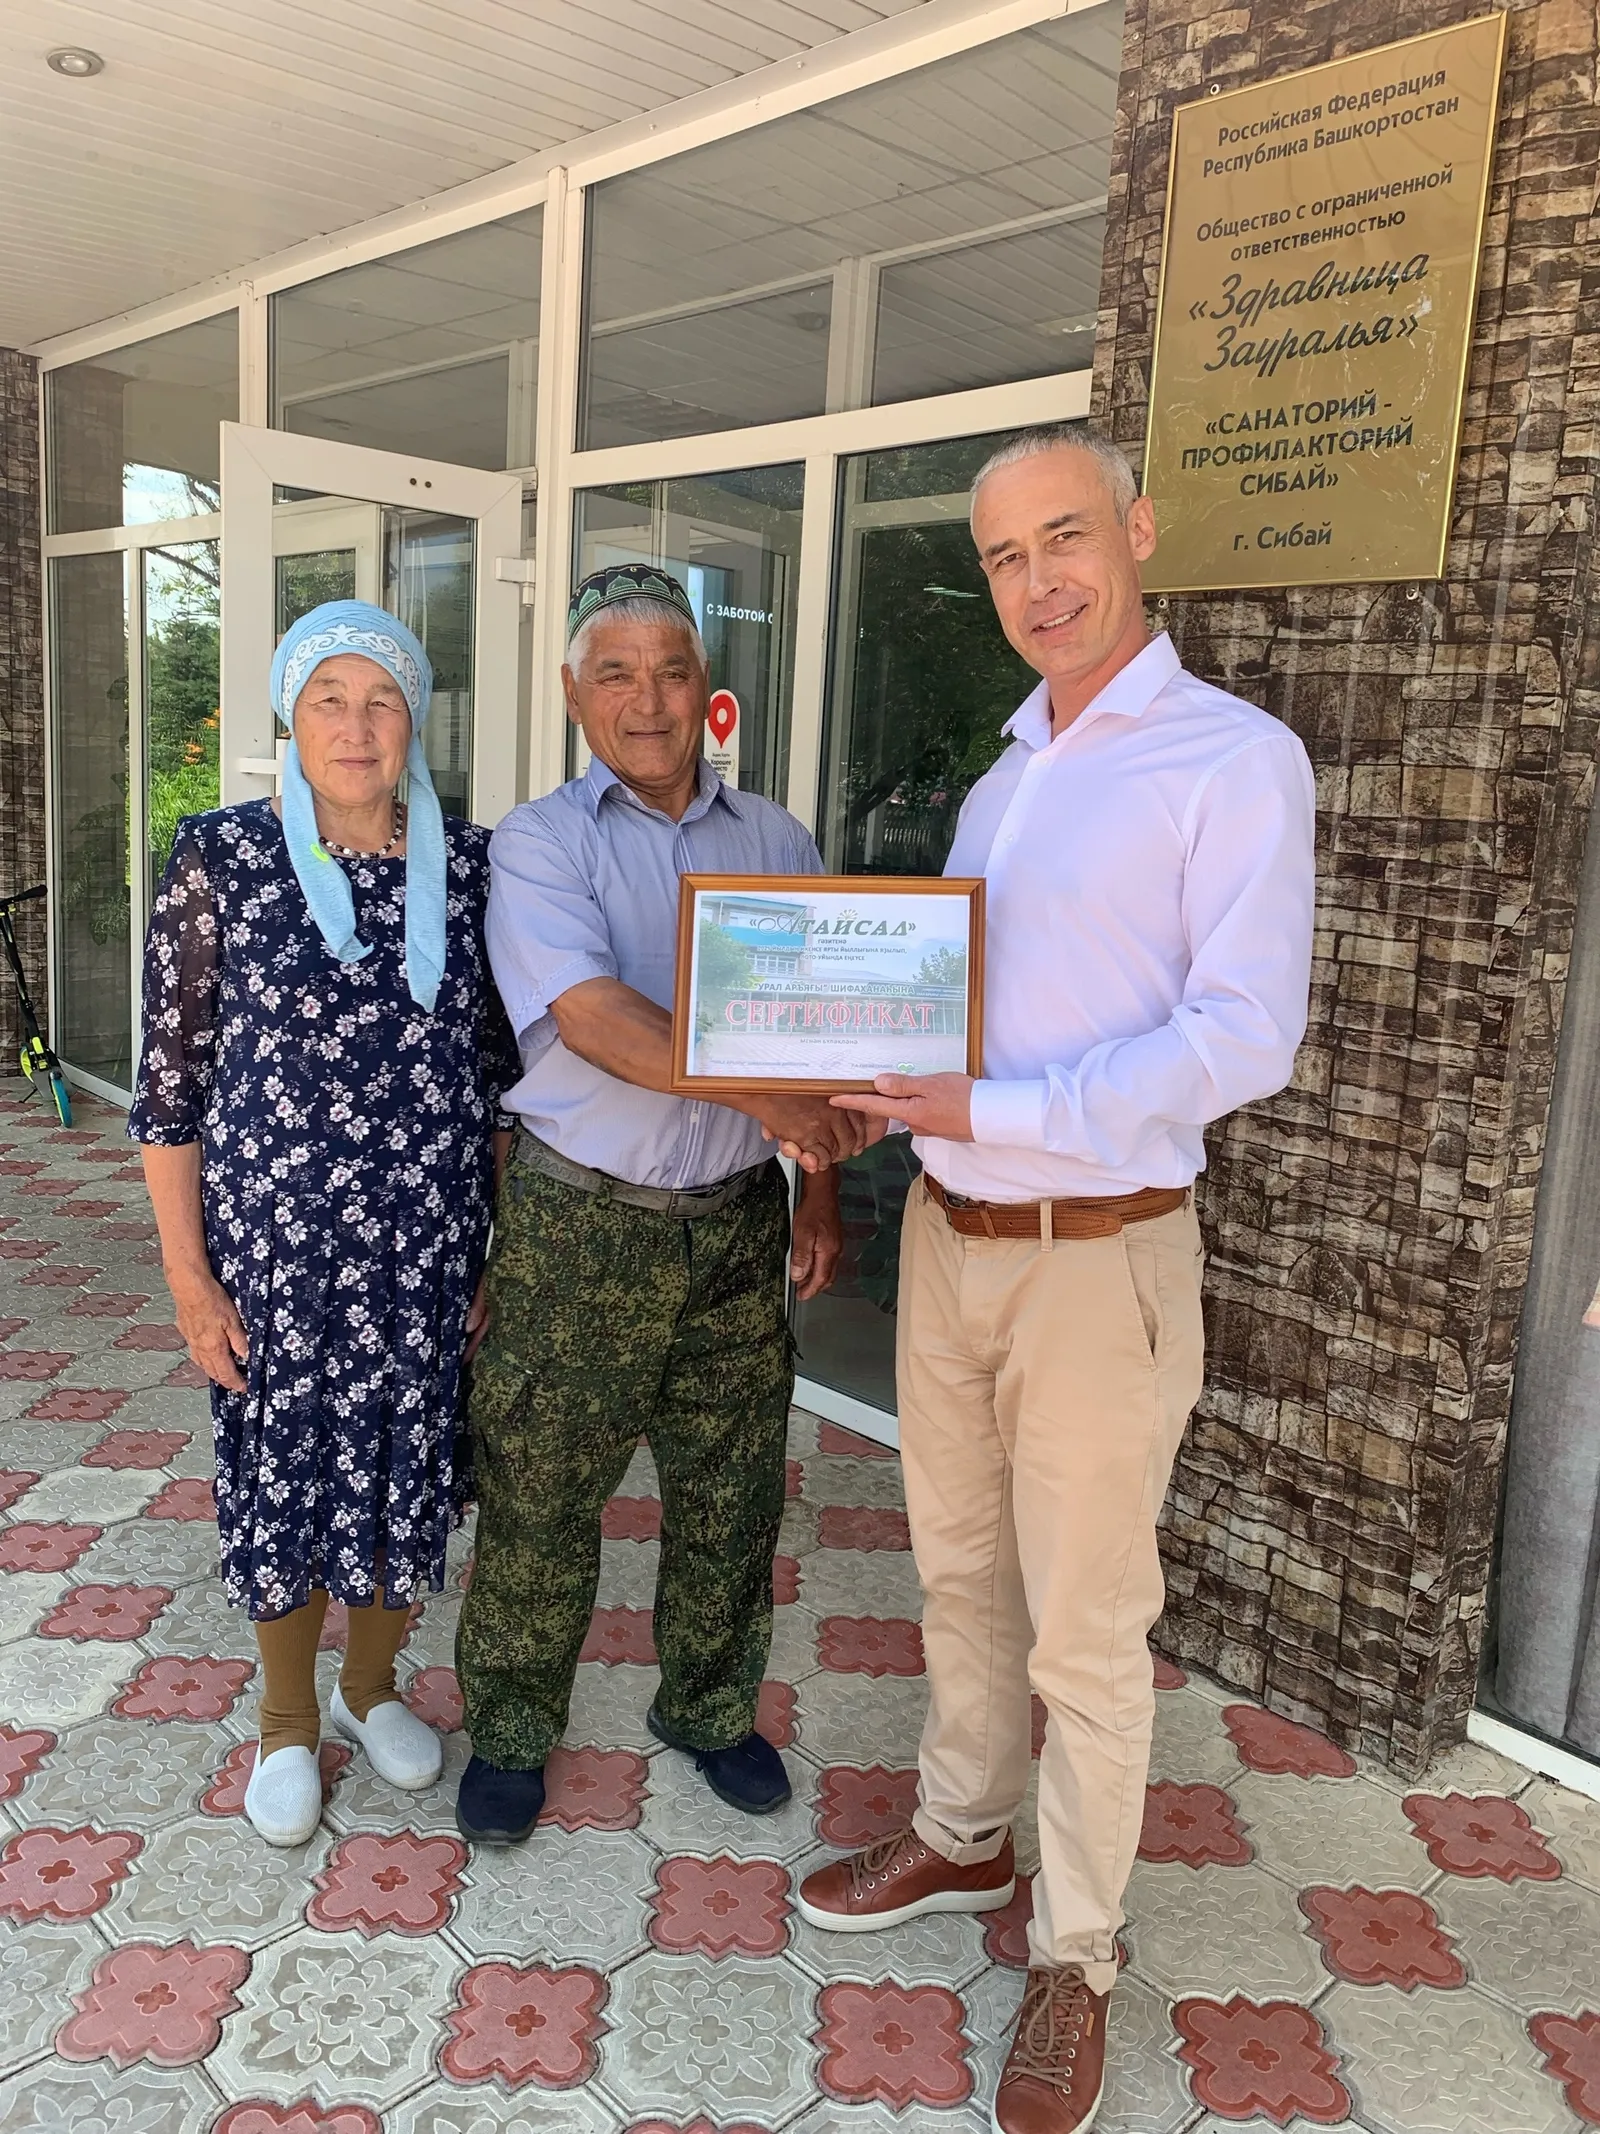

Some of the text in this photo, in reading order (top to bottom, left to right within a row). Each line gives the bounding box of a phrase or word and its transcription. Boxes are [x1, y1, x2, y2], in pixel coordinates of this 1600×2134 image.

[1217, 69, 1447, 147] Российская Федерация
[1202, 96, 1459, 178] Республика Башкортостан
[1196, 164, 1454, 243] Общество с ограниченной
[1230, 208, 1406, 262] ответственностью
[1205, 388, 1377, 436] «САНАТОРИЙ
[1180, 416, 1412, 470] ПРОФИЛАКТОРИЙ
[1239, 461, 1339, 496] СИБАЙ»
[1232, 521, 1332, 551] г. Сибай
[707, 603, 714, 615] С
[717, 604, 765, 623] ЗАБОТОЙ
[725, 1000, 935, 1028] СЕРТИФИКАТ
